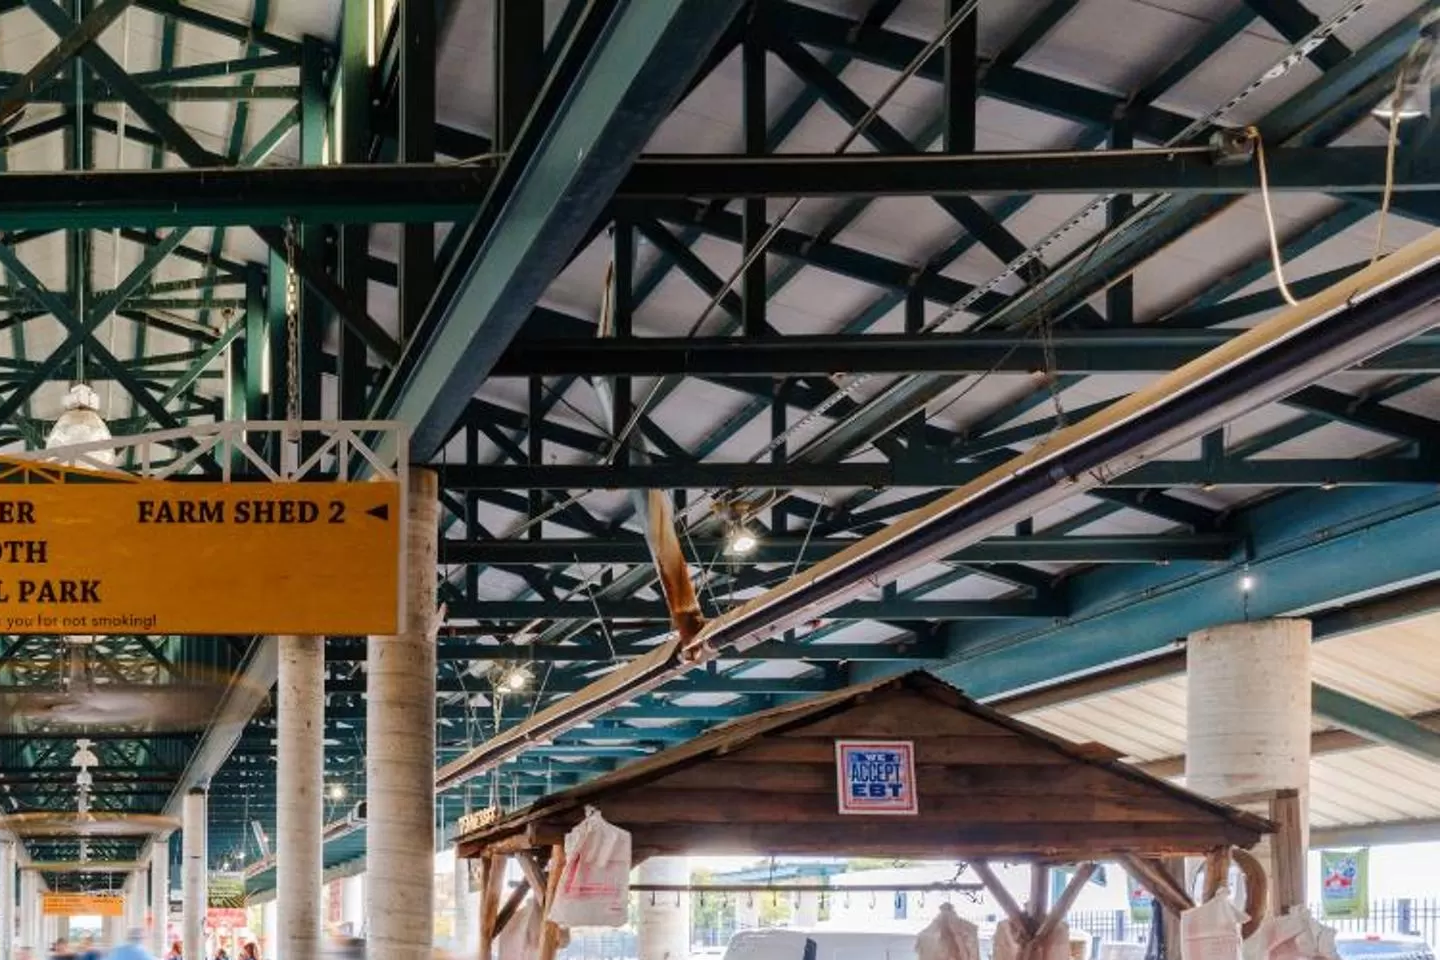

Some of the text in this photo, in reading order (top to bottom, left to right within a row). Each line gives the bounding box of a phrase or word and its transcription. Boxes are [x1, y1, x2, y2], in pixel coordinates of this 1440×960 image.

[137, 500, 346, 525] FARM SHED 2
[18, 580, 101, 603] PARK
[7, 617, 33, 629] you
[37, 613, 59, 627] for
[62, 614, 87, 627] not
[91, 613, 157, 630] smoking!
[866, 753, 887, 762] WE
[852, 763, 901, 782] ACCEPT
[852, 783, 903, 797] EBT
